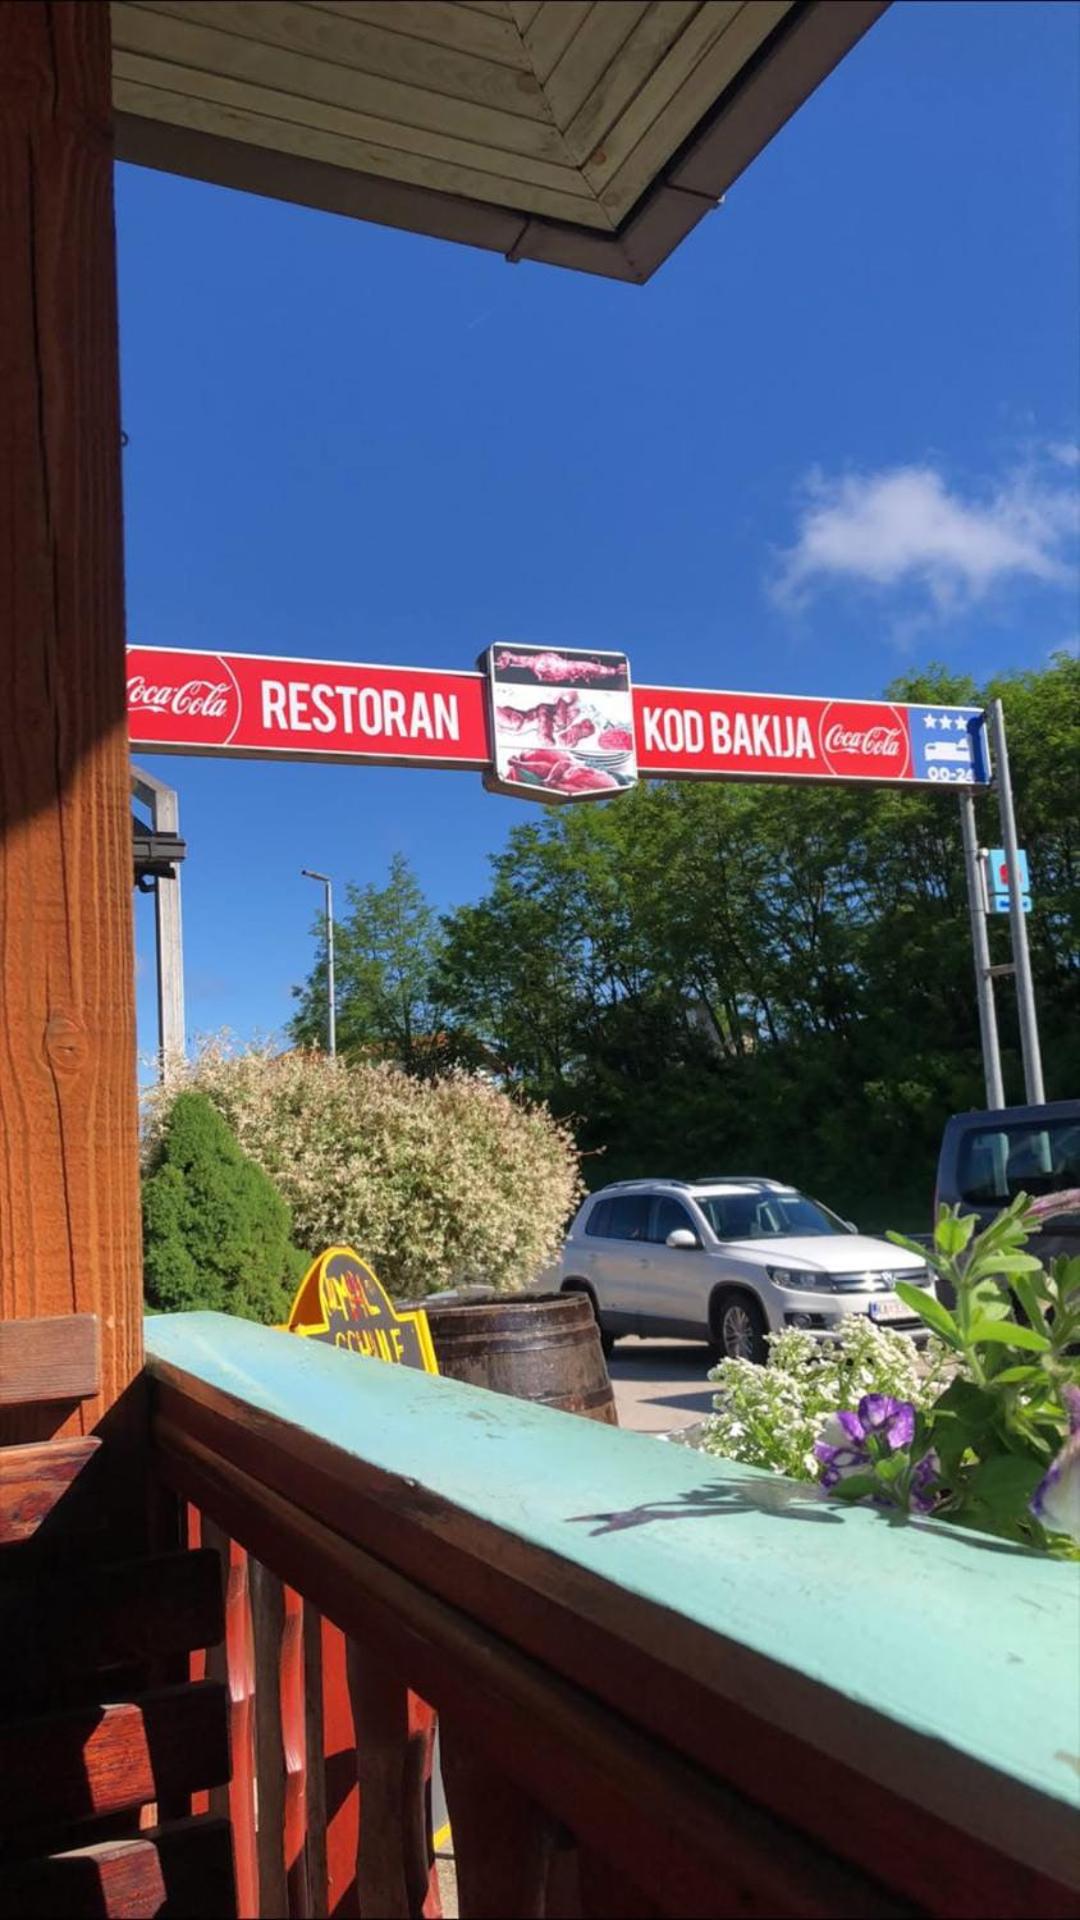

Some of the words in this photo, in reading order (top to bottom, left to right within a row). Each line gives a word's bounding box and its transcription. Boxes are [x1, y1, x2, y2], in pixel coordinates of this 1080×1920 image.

[261, 680, 459, 741] RESTORAN
[643, 707, 704, 753] KOD
[710, 711, 816, 759] BAKIJA
[825, 724, 901, 757] Coca-Cola
